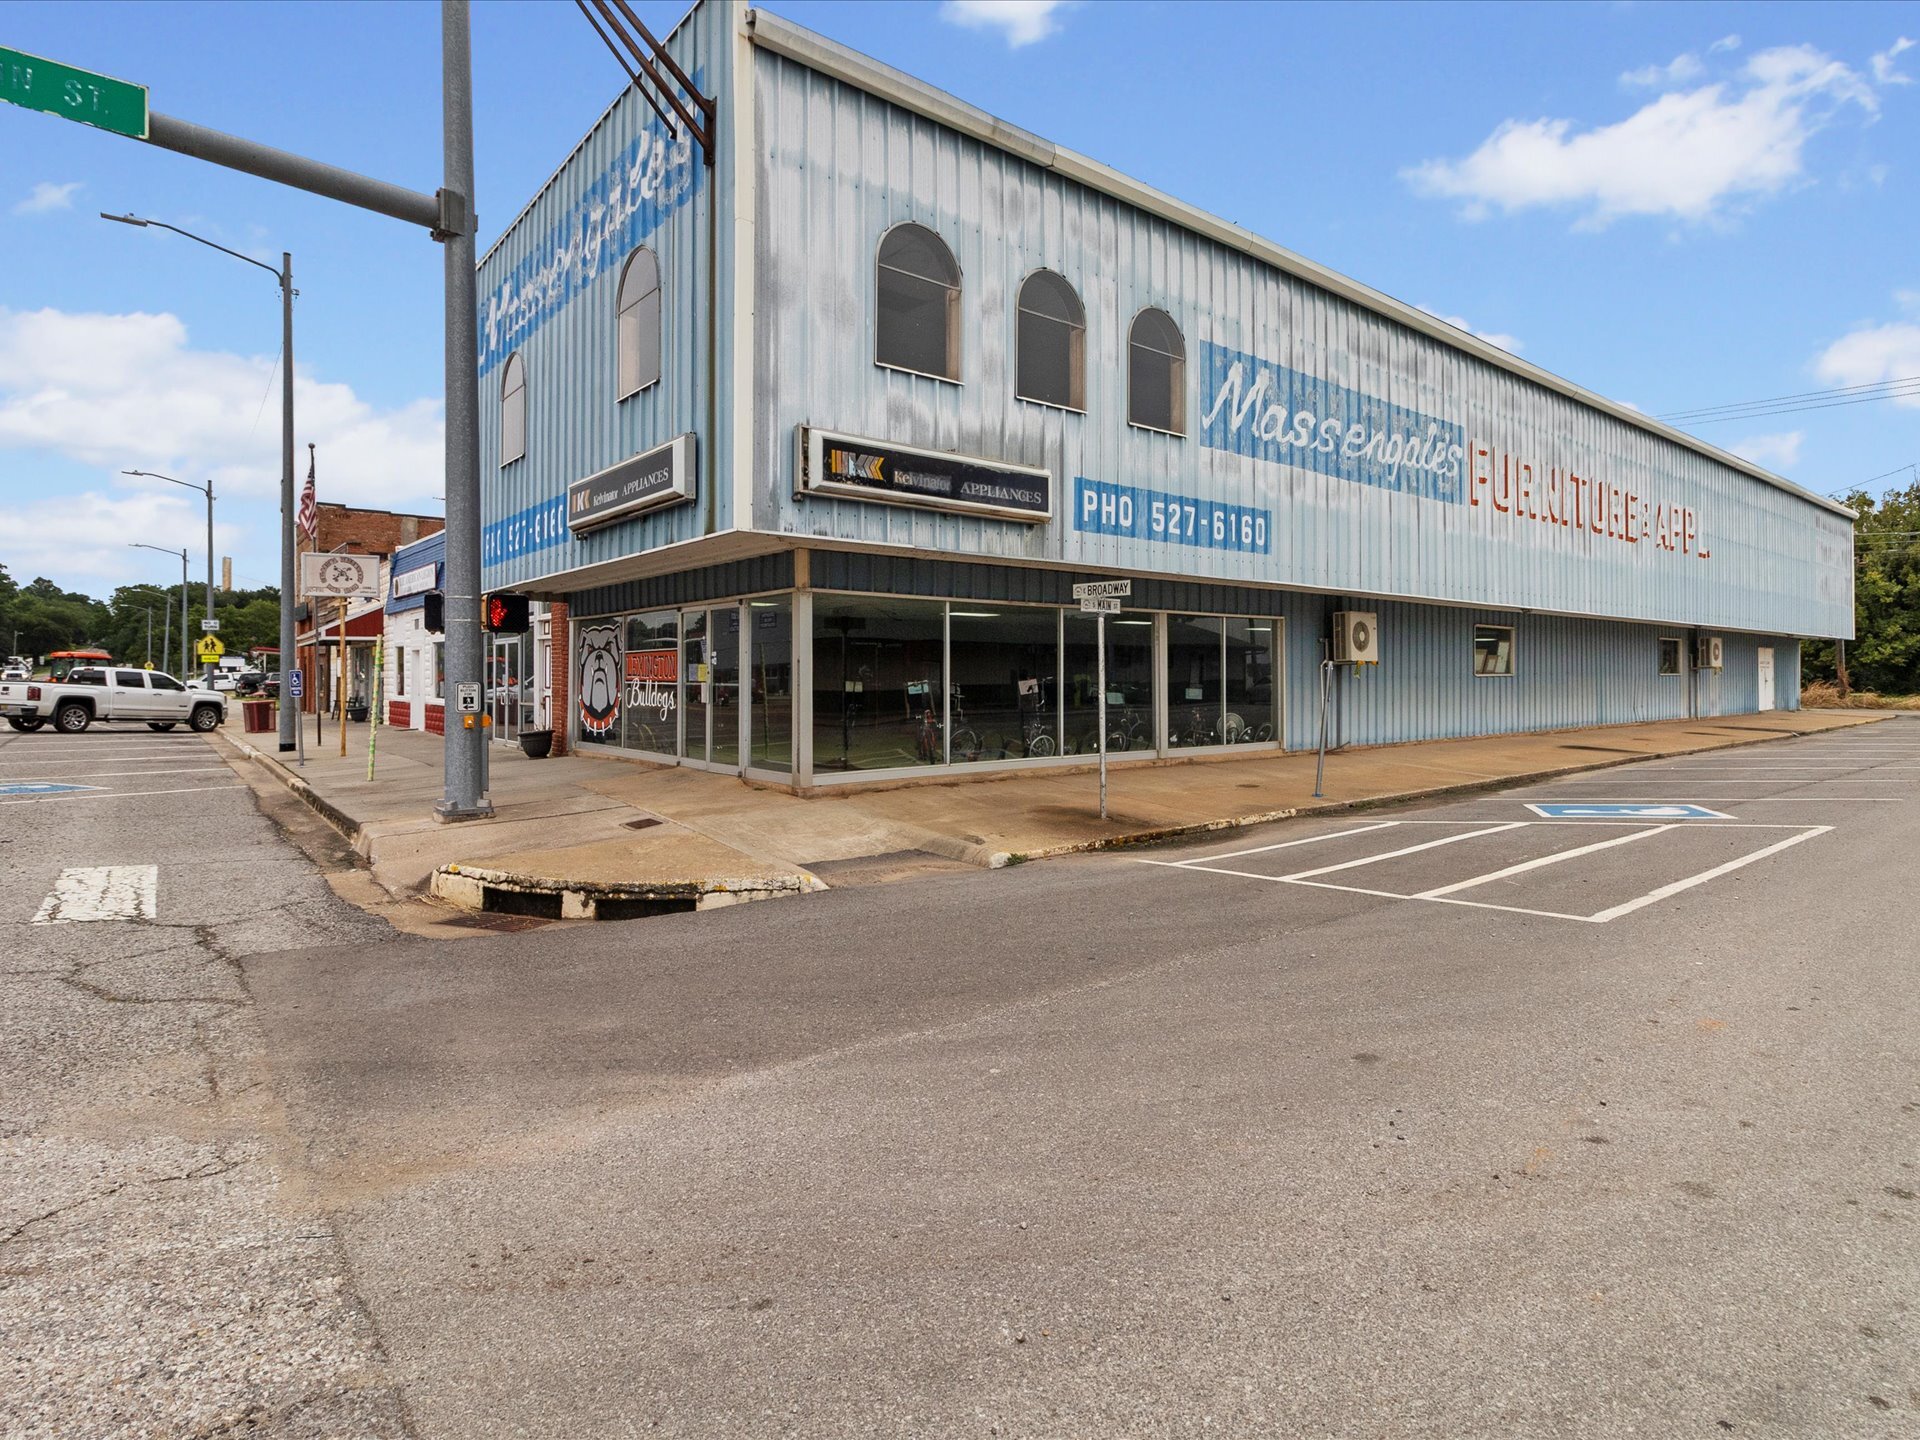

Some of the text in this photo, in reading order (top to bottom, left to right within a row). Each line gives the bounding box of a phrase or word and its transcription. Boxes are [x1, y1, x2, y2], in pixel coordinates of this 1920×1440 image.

[593, 489, 619, 507] Kelvinator
[621, 467, 670, 497] APPLIANCES
[894, 470, 953, 492] Kelvinator
[960, 481, 1043, 504] APPLIANCES
[1469, 437, 1639, 543] FURNITURE
[1082, 489, 1266, 546] PHO 527-6160
[1087, 582, 1129, 596] BROADWAY
[1097, 599, 1112, 610] MAIN
[626, 655, 676, 679] LEXINGTON
[625, 677, 677, 721] Bulldogs
